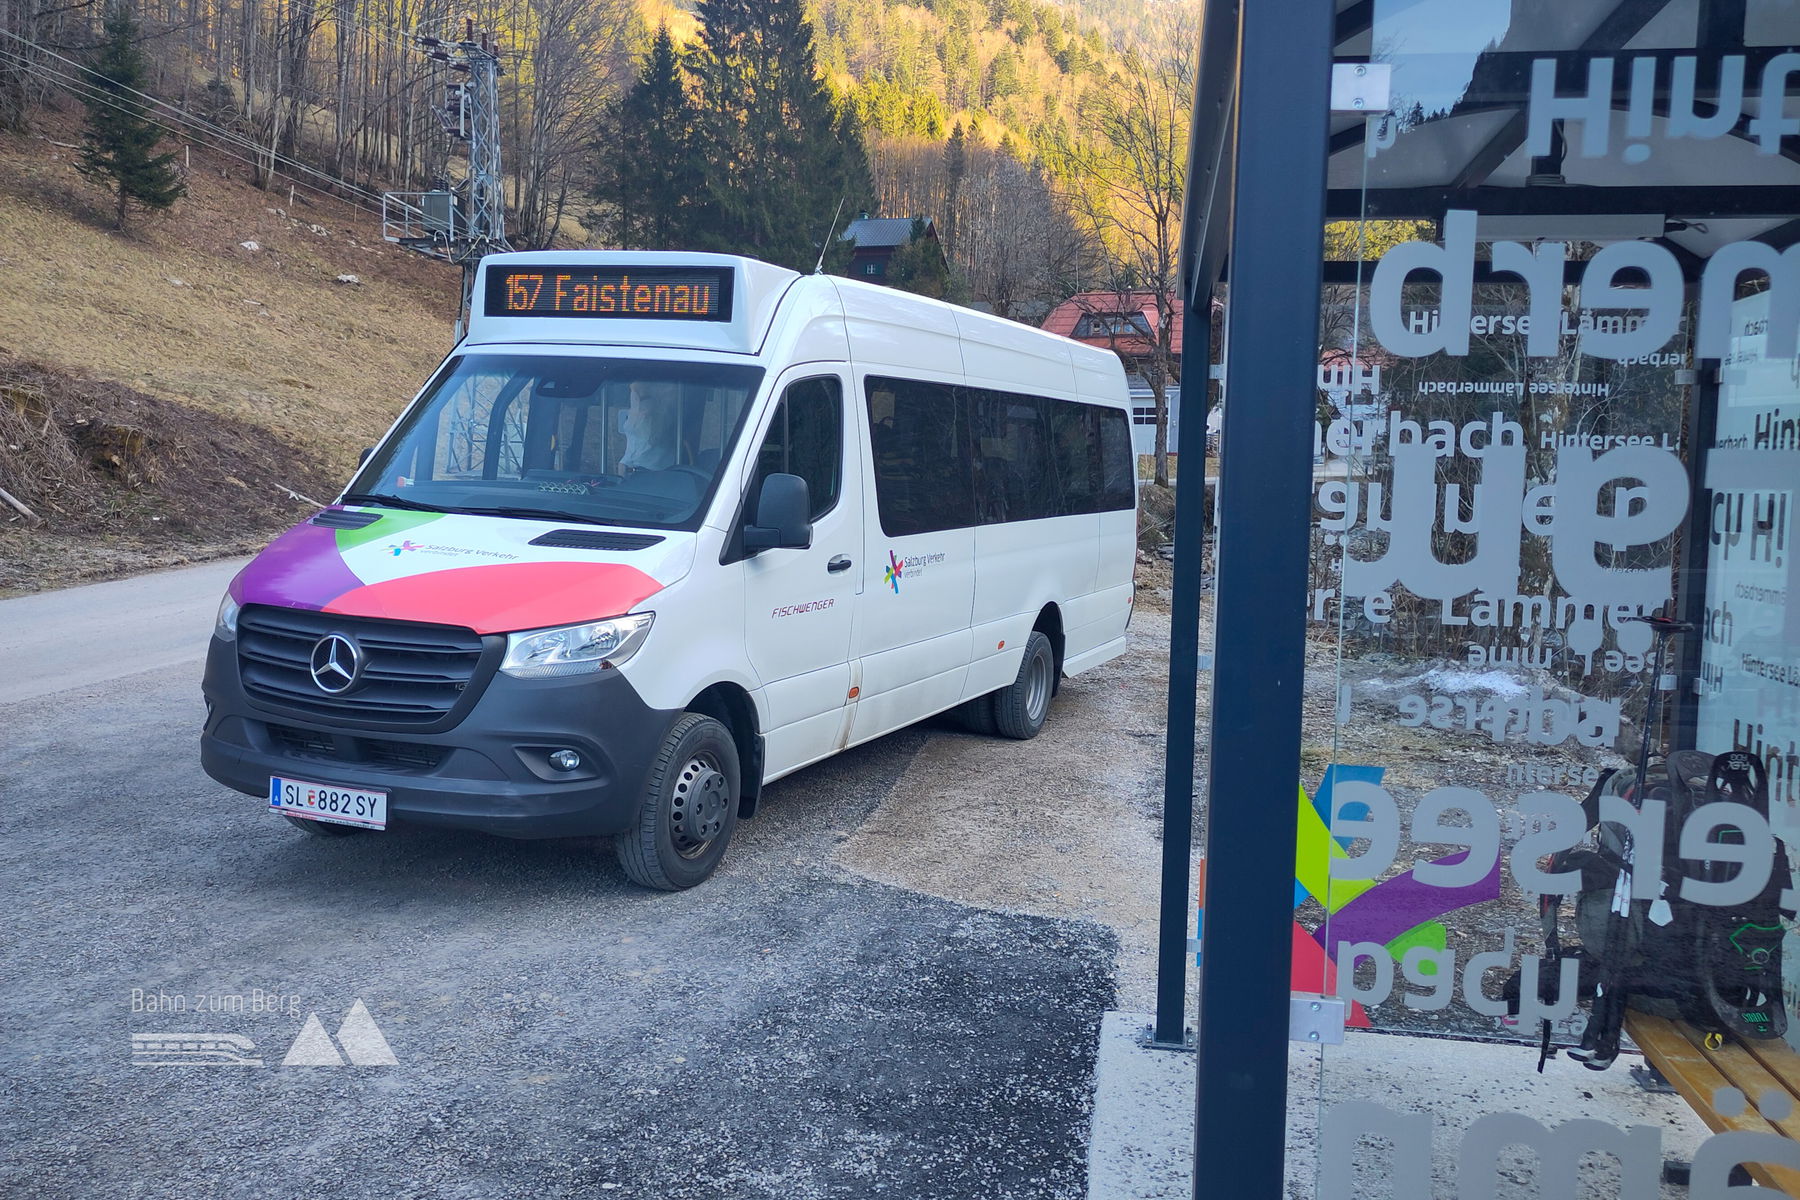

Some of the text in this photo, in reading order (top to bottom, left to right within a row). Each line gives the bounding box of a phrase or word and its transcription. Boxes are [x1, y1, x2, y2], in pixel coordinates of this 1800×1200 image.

[506, 274, 709, 315] 157 Faistenau
[1418, 381, 1609, 399] Hintersee Lämmerbach
[1540, 431, 1655, 450] Hintersee
[426, 544, 519, 561] Salzburg Verkehr
[771, 598, 835, 619] FISCHWENGER
[285, 785, 304, 807] SL
[318, 790, 350, 814] 882
[355, 795, 377, 818] SY
